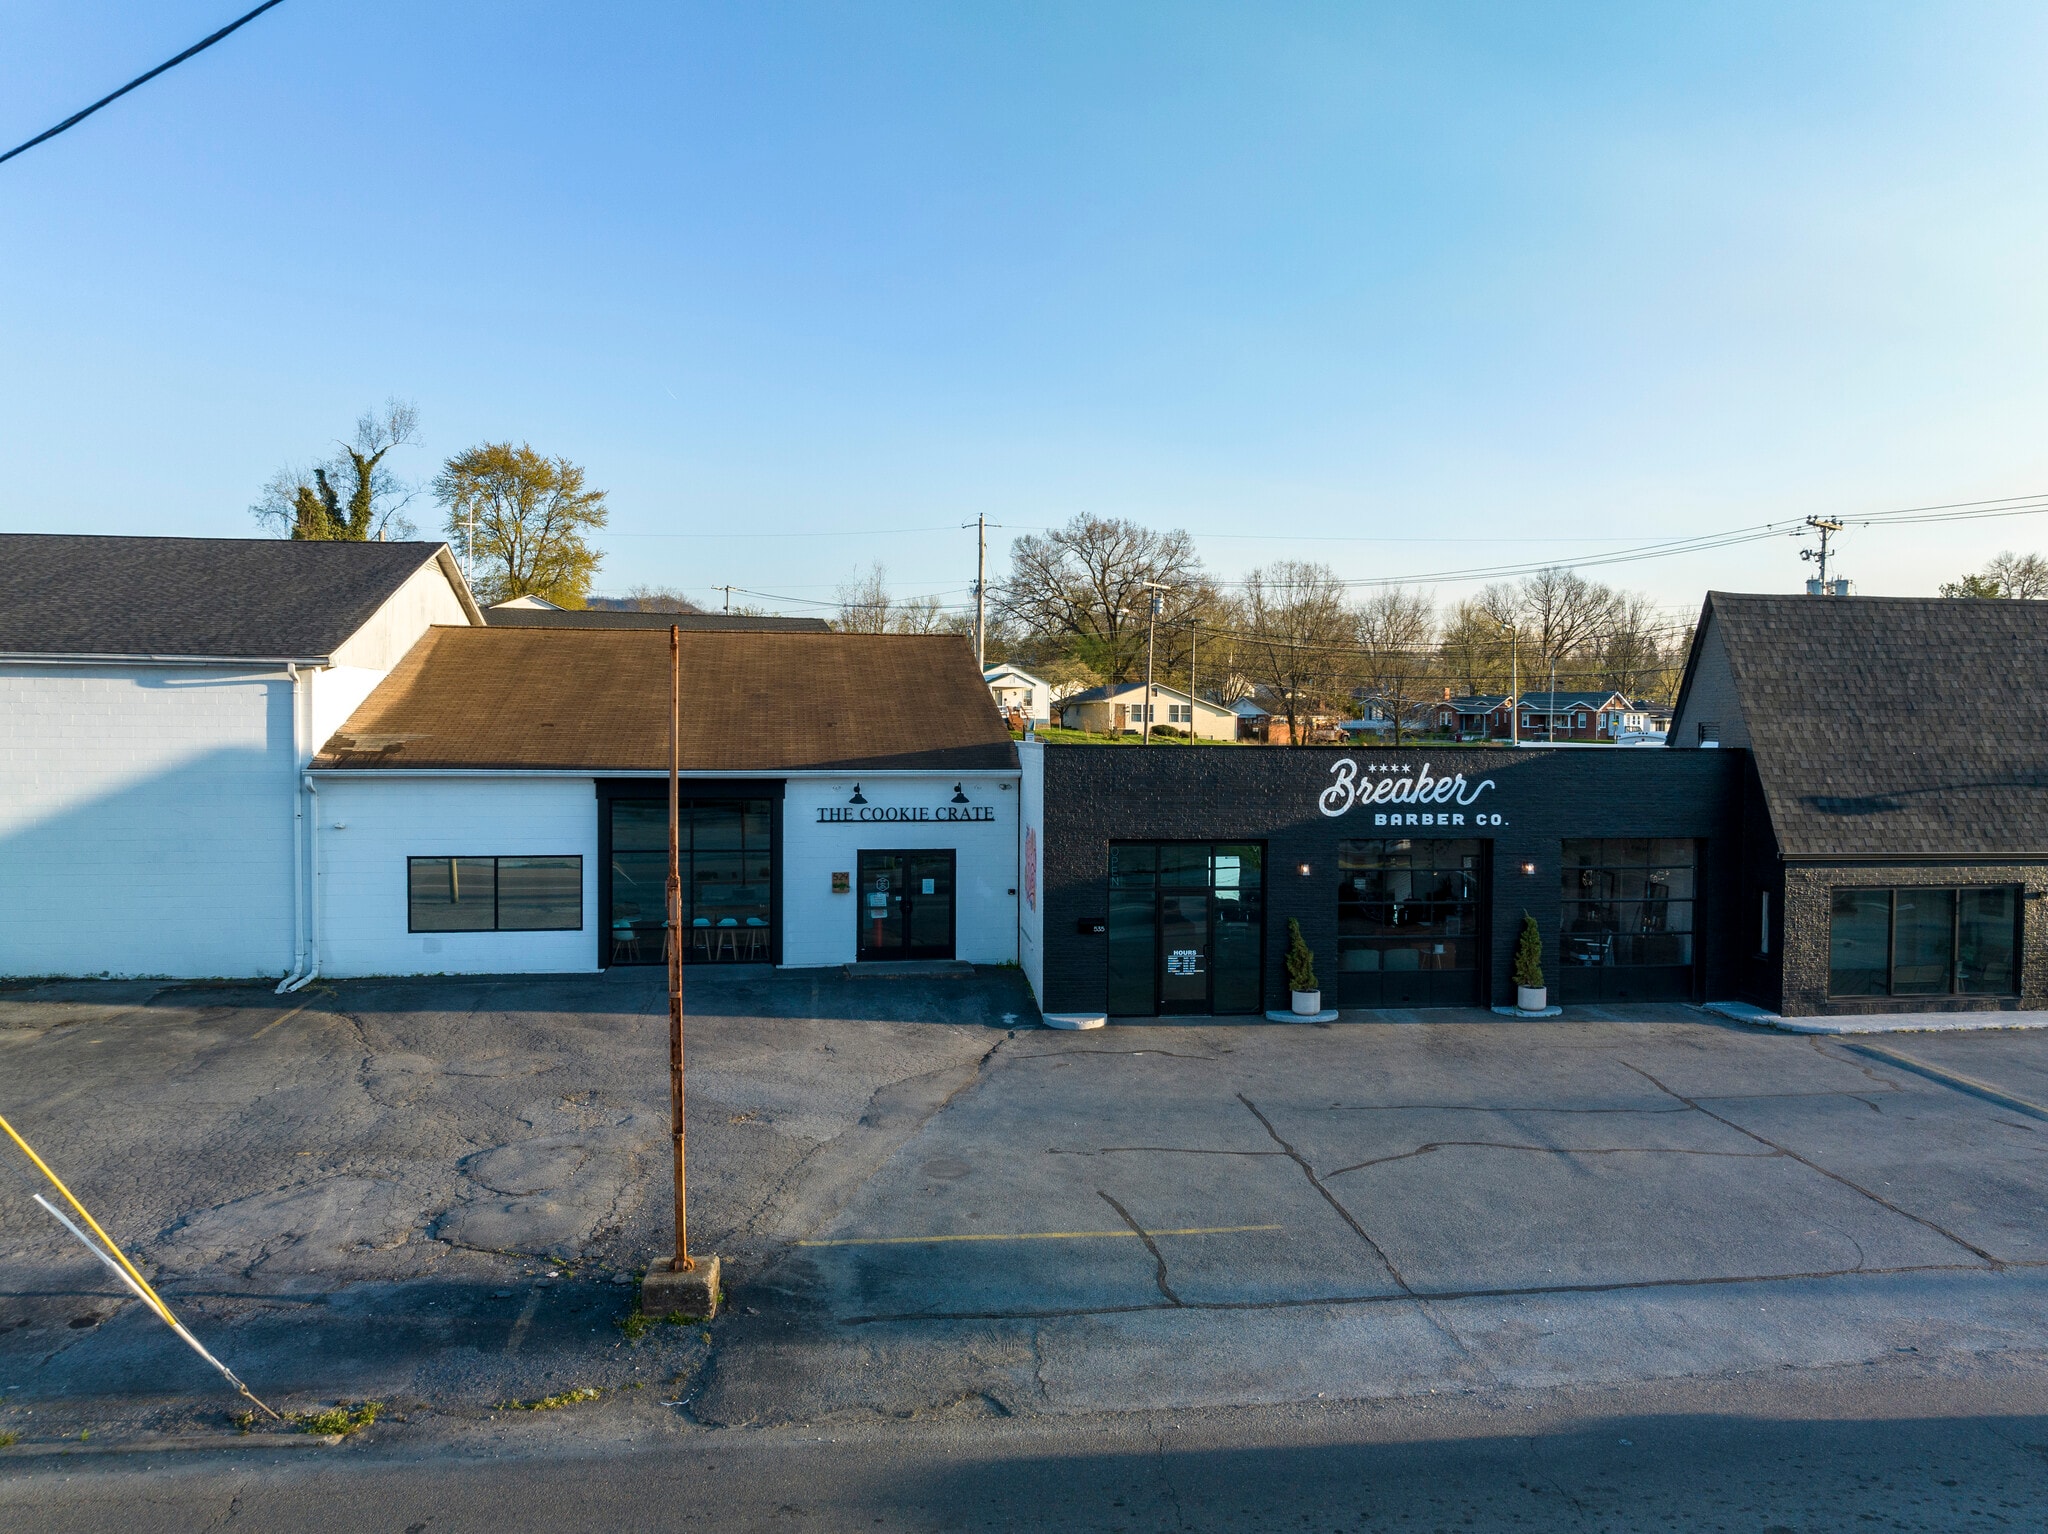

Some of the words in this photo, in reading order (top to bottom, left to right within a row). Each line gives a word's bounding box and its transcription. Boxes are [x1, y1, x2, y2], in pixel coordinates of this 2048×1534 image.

[1318, 758, 1496, 817] Breaker
[816, 807, 854, 821] THE
[859, 807, 930, 821] COOKIE
[935, 806, 994, 821] CRATE
[1374, 813, 1465, 826] BARBER
[1476, 813, 1510, 826] CO.
[1110, 847, 1119, 886] OPEN
[832, 872, 849, 881] 529
